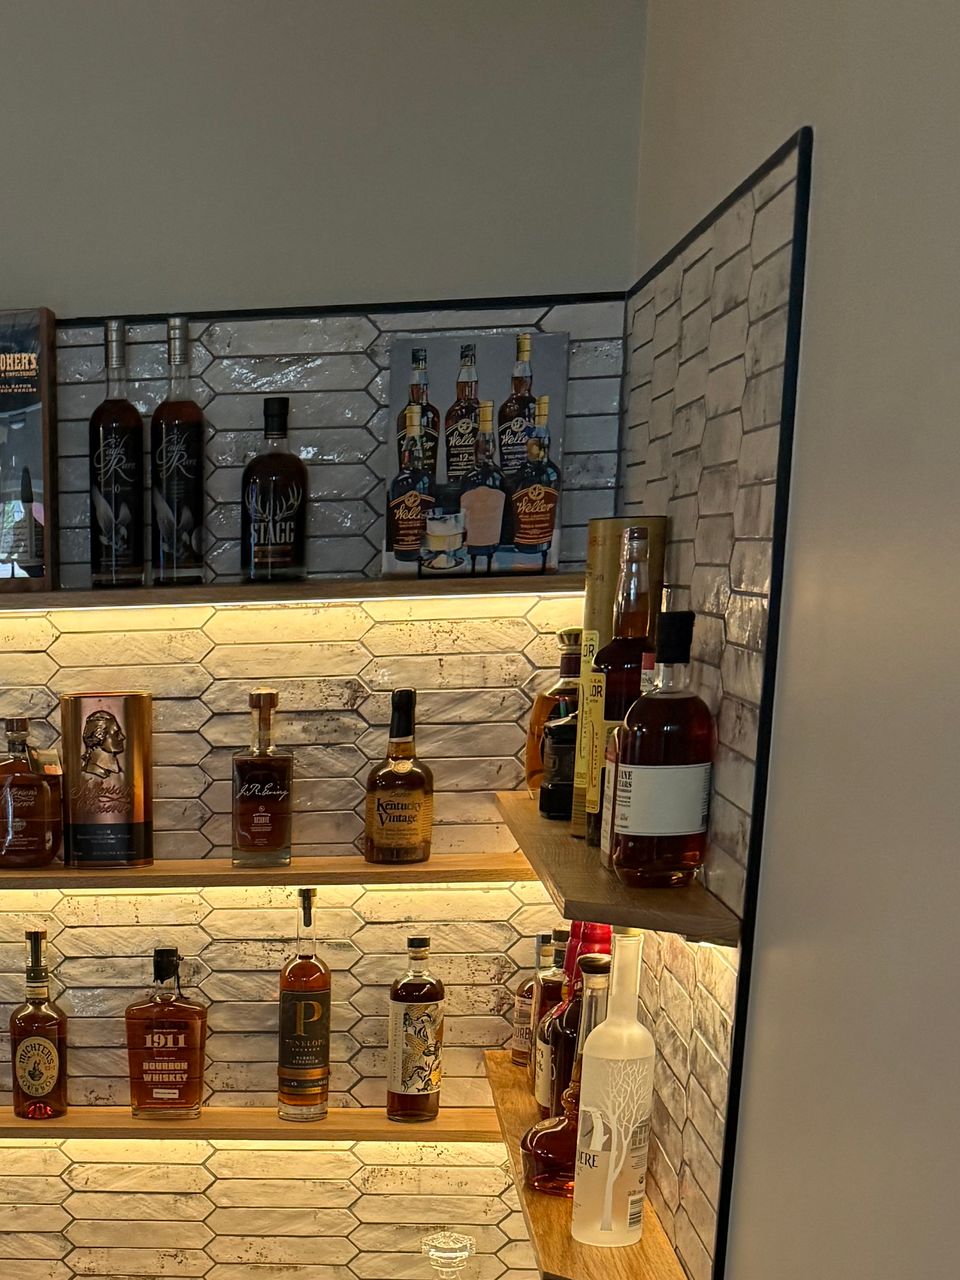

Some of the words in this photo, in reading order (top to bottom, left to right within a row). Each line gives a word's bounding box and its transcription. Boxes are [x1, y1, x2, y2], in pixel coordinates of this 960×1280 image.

[517, 497, 554, 514] Weller
[376, 798, 422, 816] Kentucky
[378, 812, 418, 827] Vintage
[292, 1001, 323, 1036] P
[143, 1034, 188, 1048] 1911
[143, 1062, 188, 1070] BOURBON
[143, 1073, 188, 1082] WHISKEY
